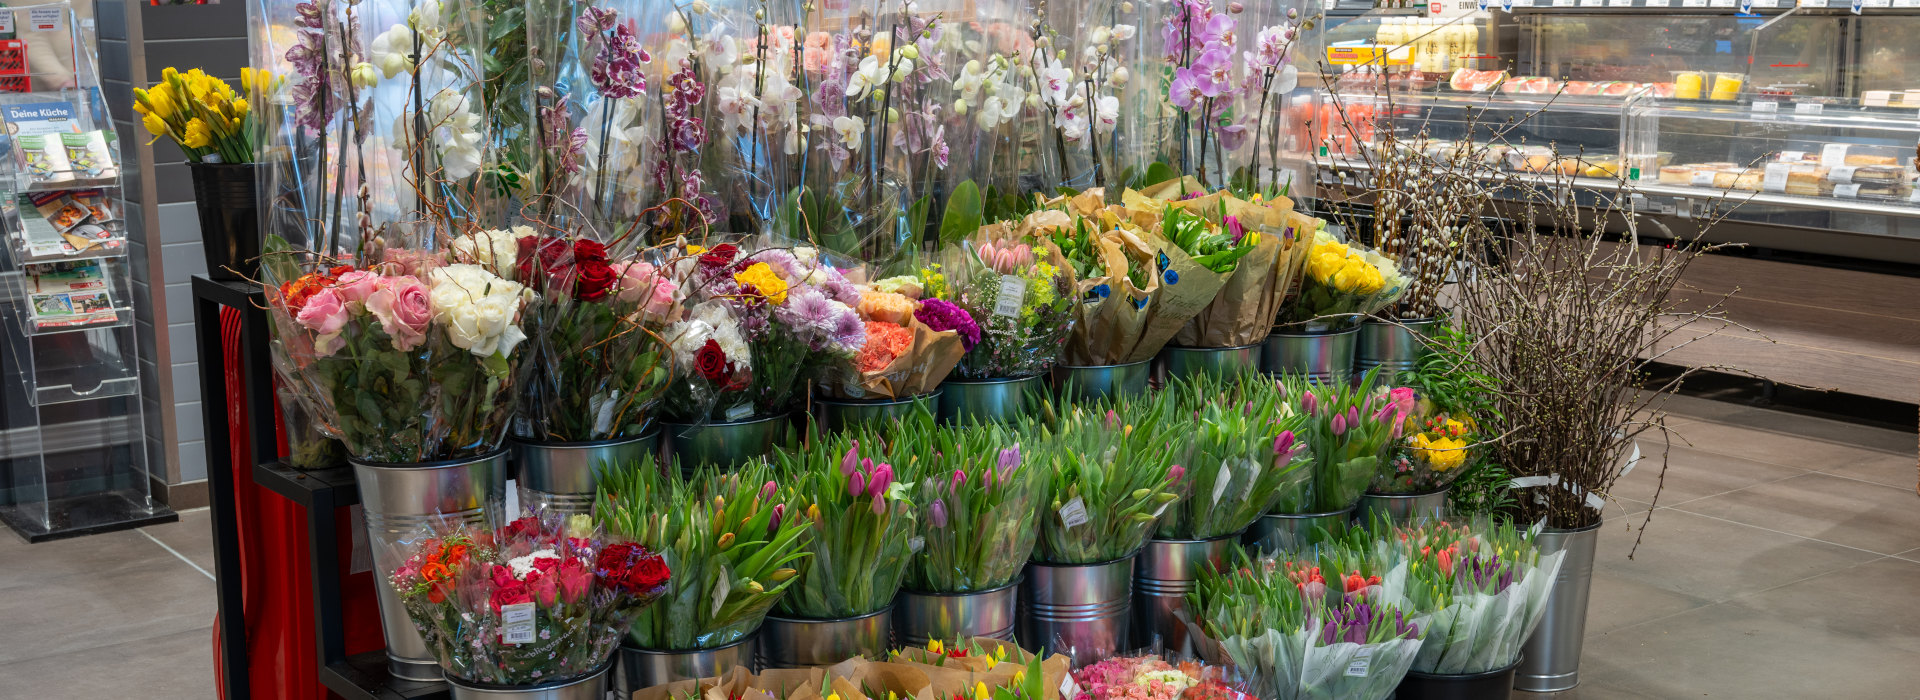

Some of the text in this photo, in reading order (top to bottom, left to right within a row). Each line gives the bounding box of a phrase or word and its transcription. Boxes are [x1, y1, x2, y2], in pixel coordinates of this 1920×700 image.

[1459, 2, 1478, 10] EINWE
[10, 108, 68, 118] Deine Küche
